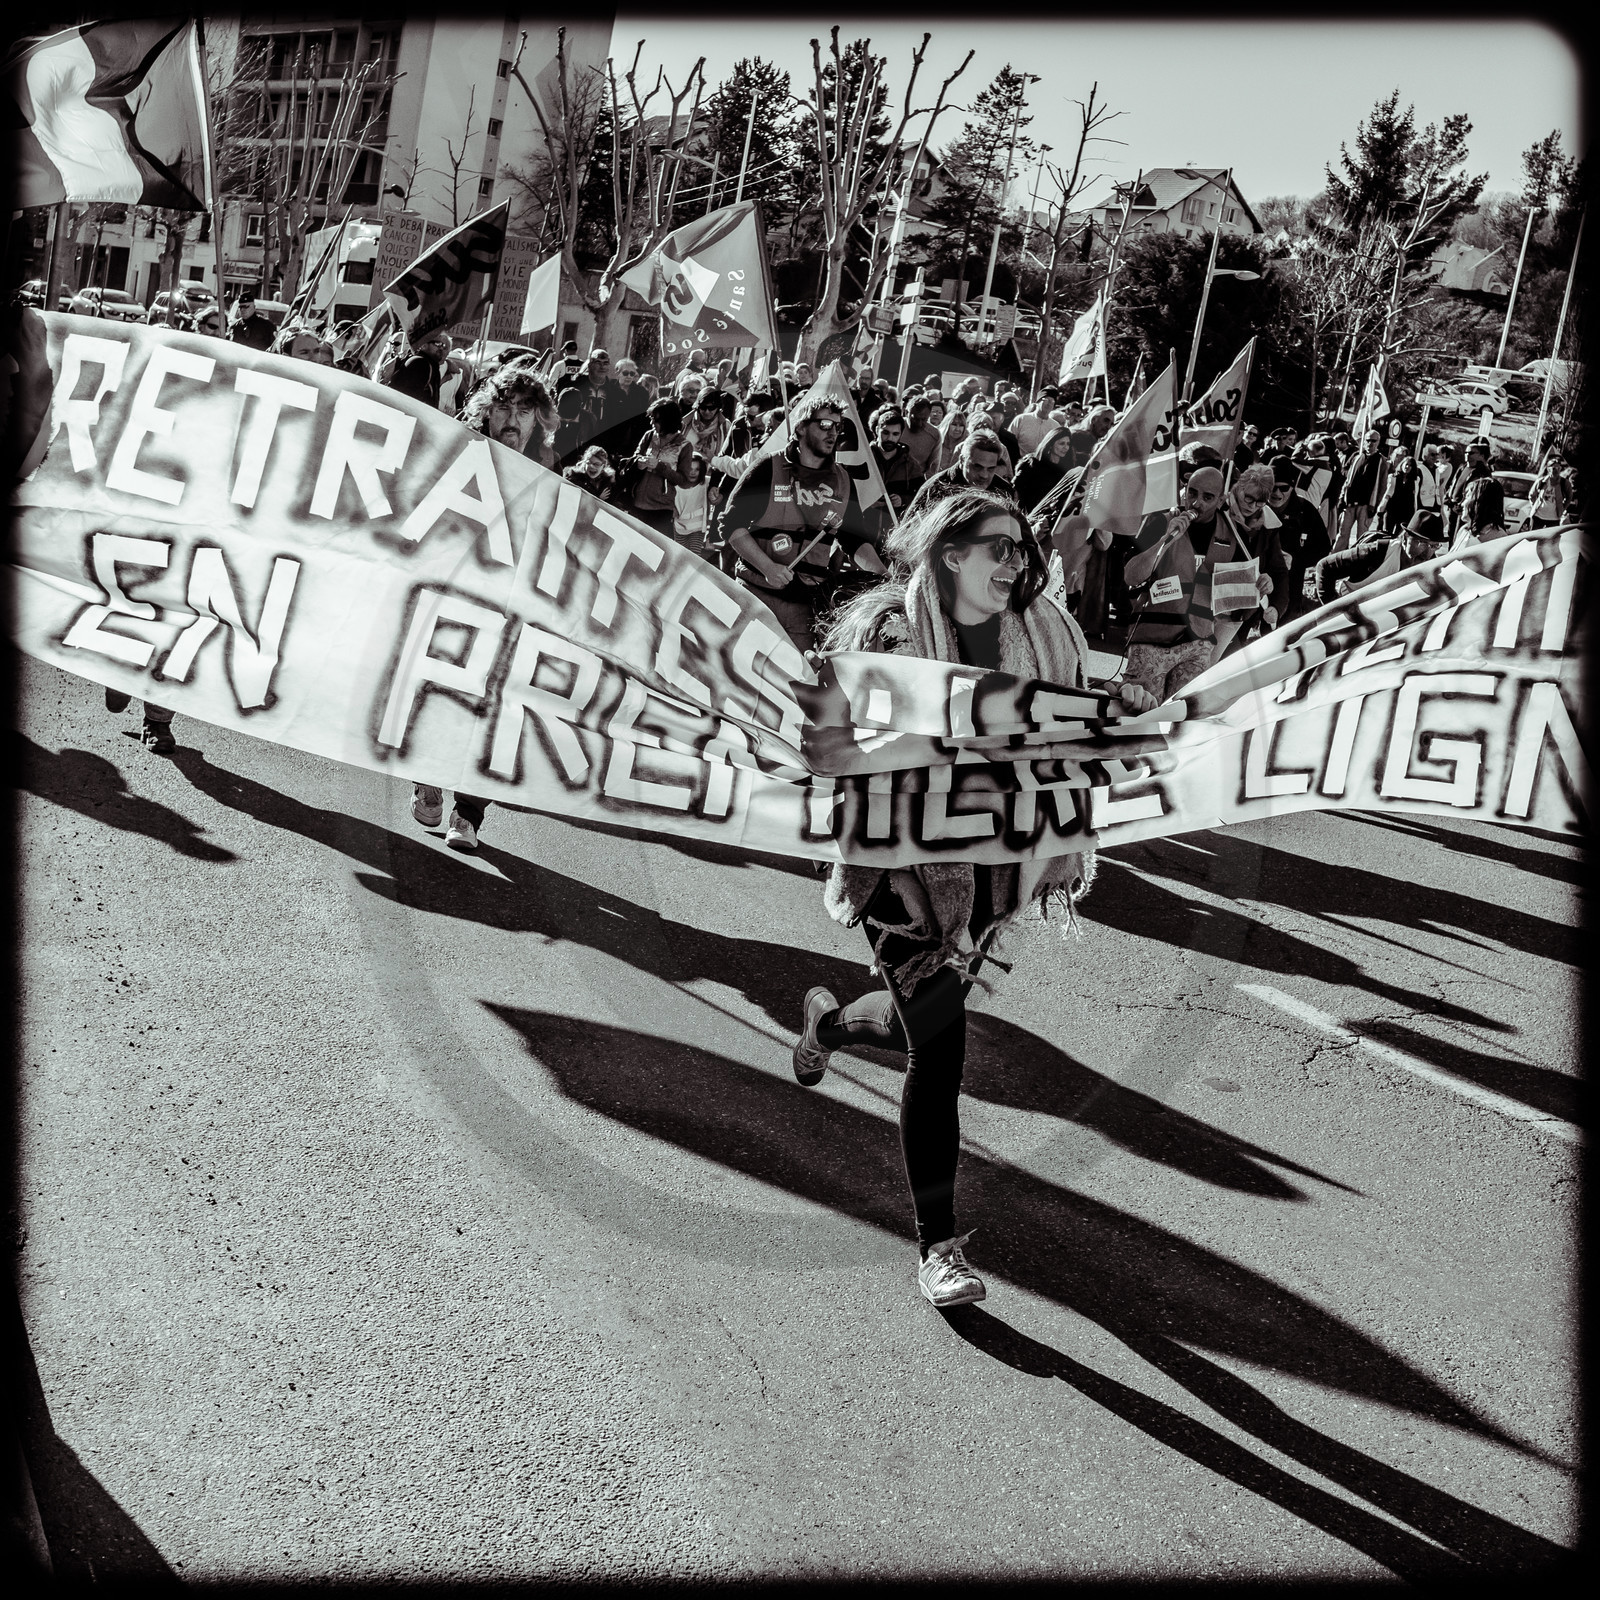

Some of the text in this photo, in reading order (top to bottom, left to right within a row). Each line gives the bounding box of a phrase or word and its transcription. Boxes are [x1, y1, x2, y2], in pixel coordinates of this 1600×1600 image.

[383, 228, 418, 245] CANCER
[380, 254, 409, 268] NOUS
[503, 265, 526, 277] VIE
[496, 304, 525, 316] ISME
[50, 333, 817, 733] RETRAITES
[62, 532, 300, 709] EN
